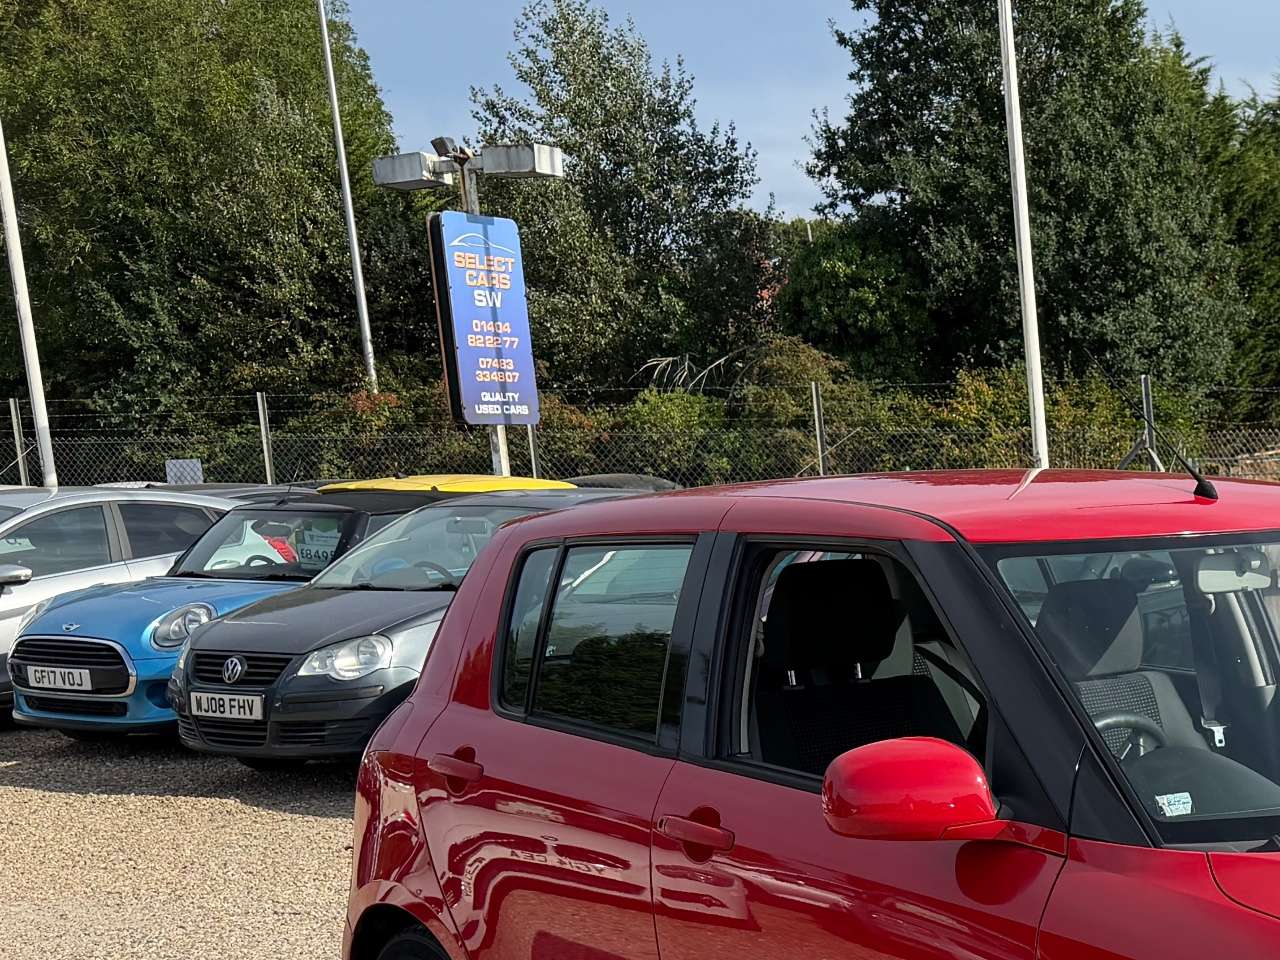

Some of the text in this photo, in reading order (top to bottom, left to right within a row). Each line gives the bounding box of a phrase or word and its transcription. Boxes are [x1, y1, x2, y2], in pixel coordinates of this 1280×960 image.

[454, 252, 515, 272] SELECT
[465, 270, 512, 290] CARS
[474, 289, 502, 308] SW
[472, 320, 511, 334] 01404
[480, 391, 520, 402] QUALITY
[474, 404, 529, 415] USED CARS
[34, 668, 84, 687] GF17 VOJ
[195, 695, 254, 716] WJ08 FHV
